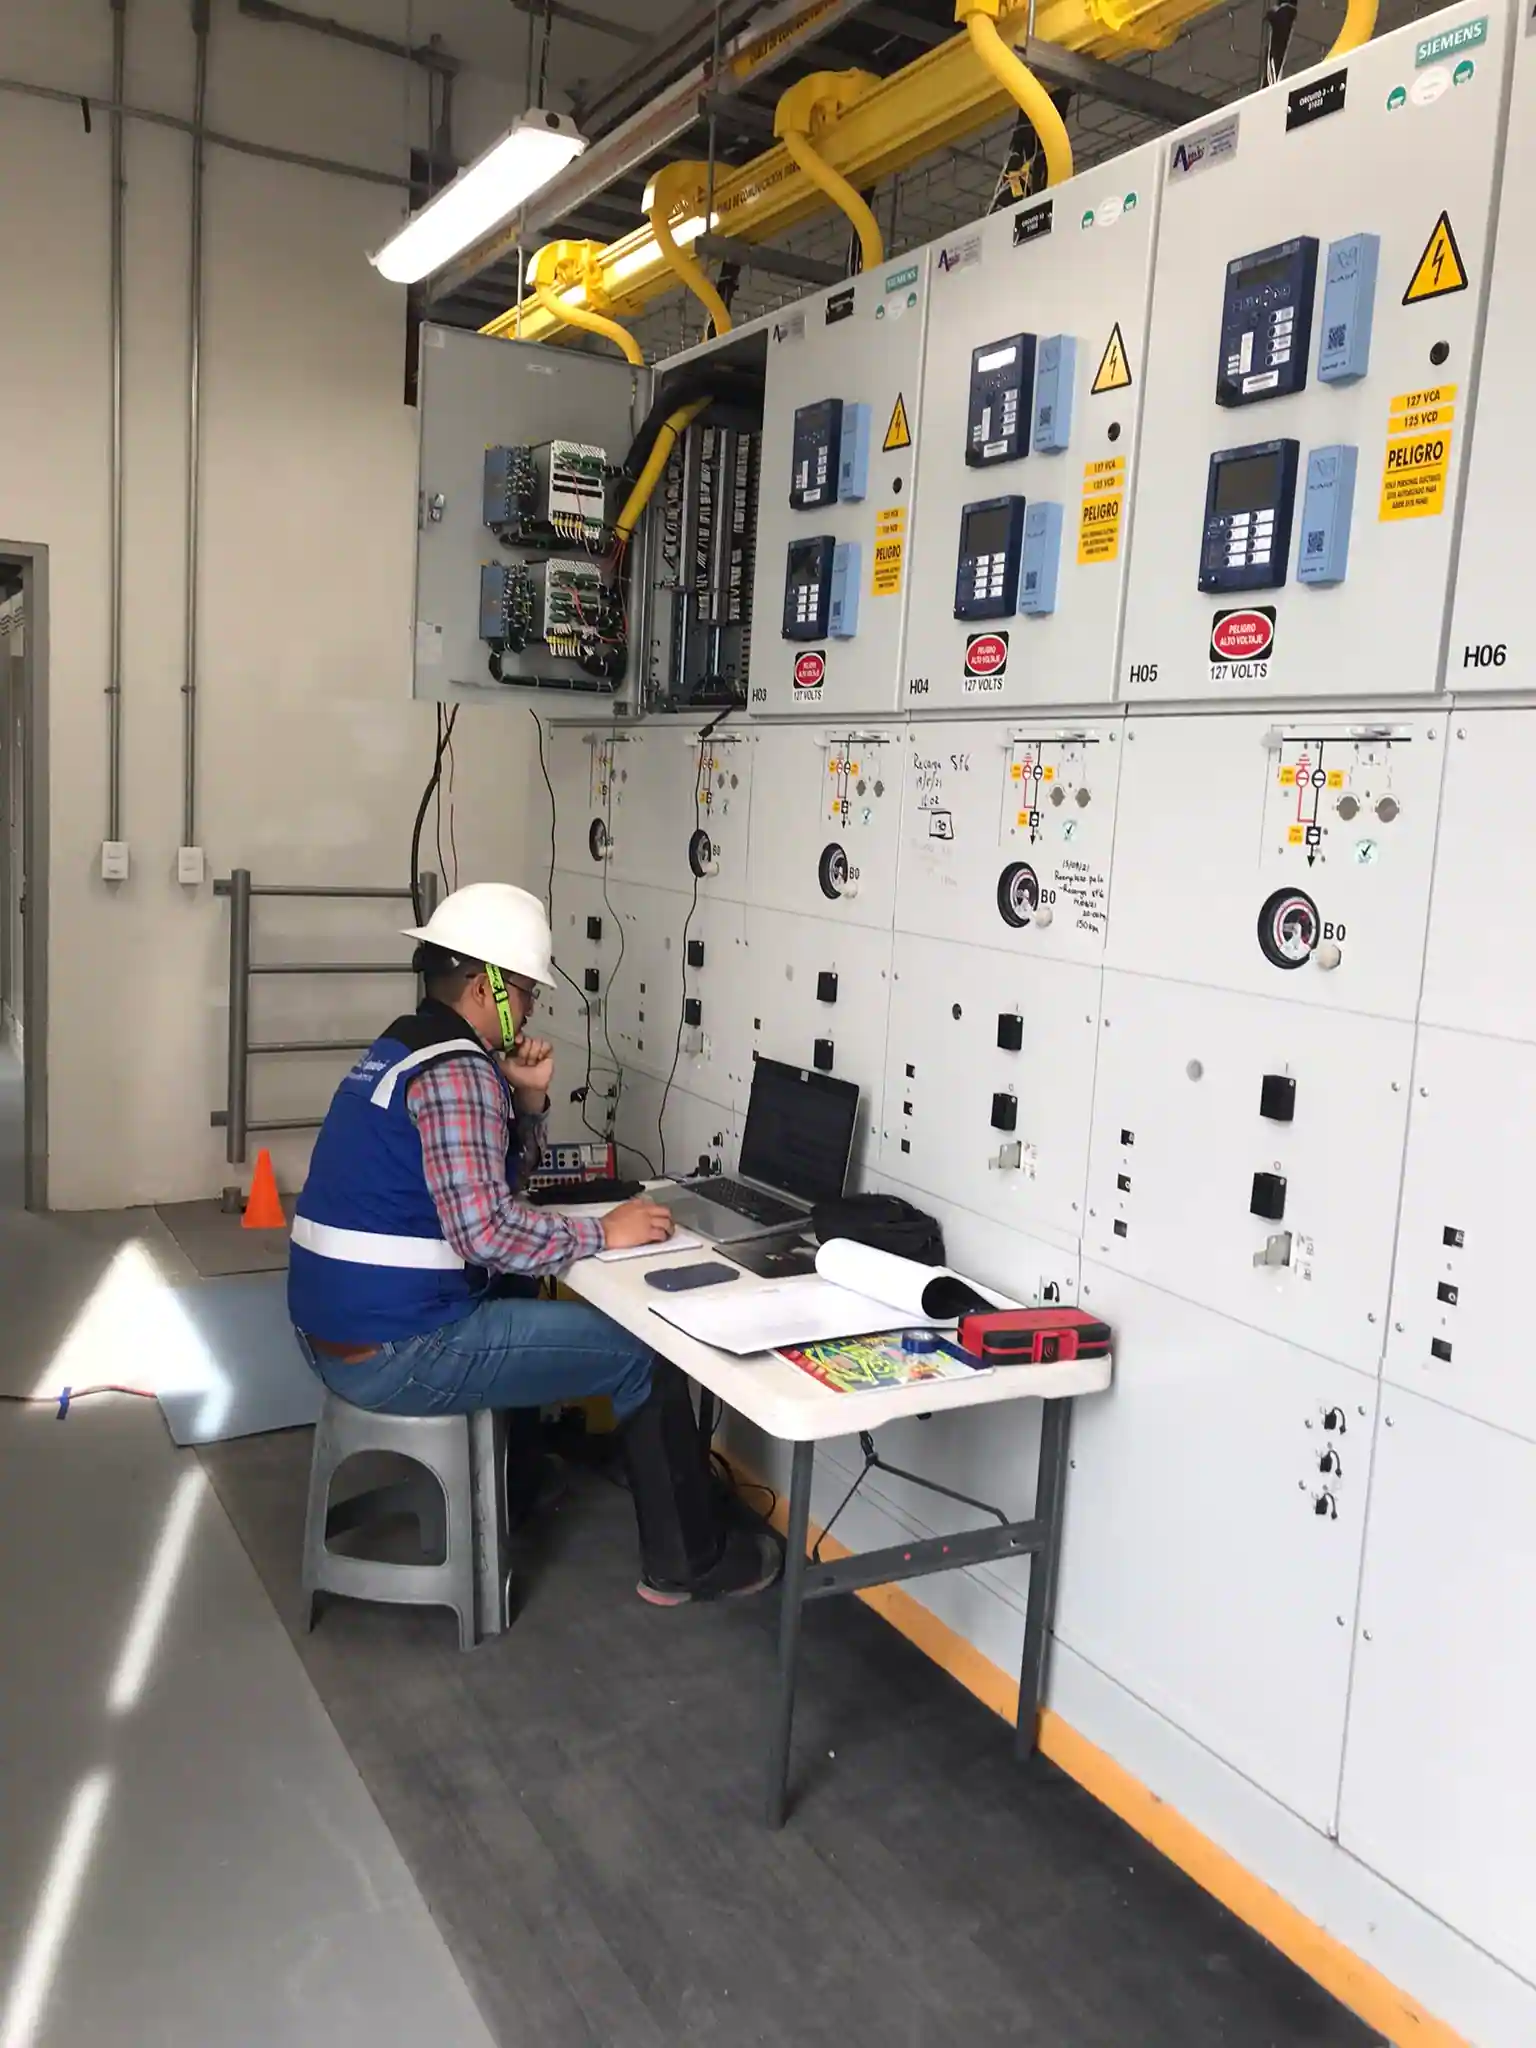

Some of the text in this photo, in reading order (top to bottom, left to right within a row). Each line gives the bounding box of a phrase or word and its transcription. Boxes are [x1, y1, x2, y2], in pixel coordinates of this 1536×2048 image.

[1418, 22, 1483, 61] SIEMENS
[1405, 389, 1441, 408] 127 VCA
[1404, 410, 1438, 428] 125 VCD
[1387, 440, 1444, 469] PELIGRO
[1083, 500, 1119, 522] PELIGRO
[876, 544, 901, 561] PELIGRO
[1228, 622, 1257, 635] PELIGRO
[1219, 634, 1264, 647] ALTO VOLTAJE
[1463, 644, 1507, 668] H06
[1129, 664, 1158, 683] H05
[1209, 662, 1268, 680] 127 VOLTS
[909, 679, 929, 695] H04
[964, 677, 1003, 692] 127 VOLTS
[751, 687, 768, 702] H03
[803, 690, 822, 701] VOLTS
